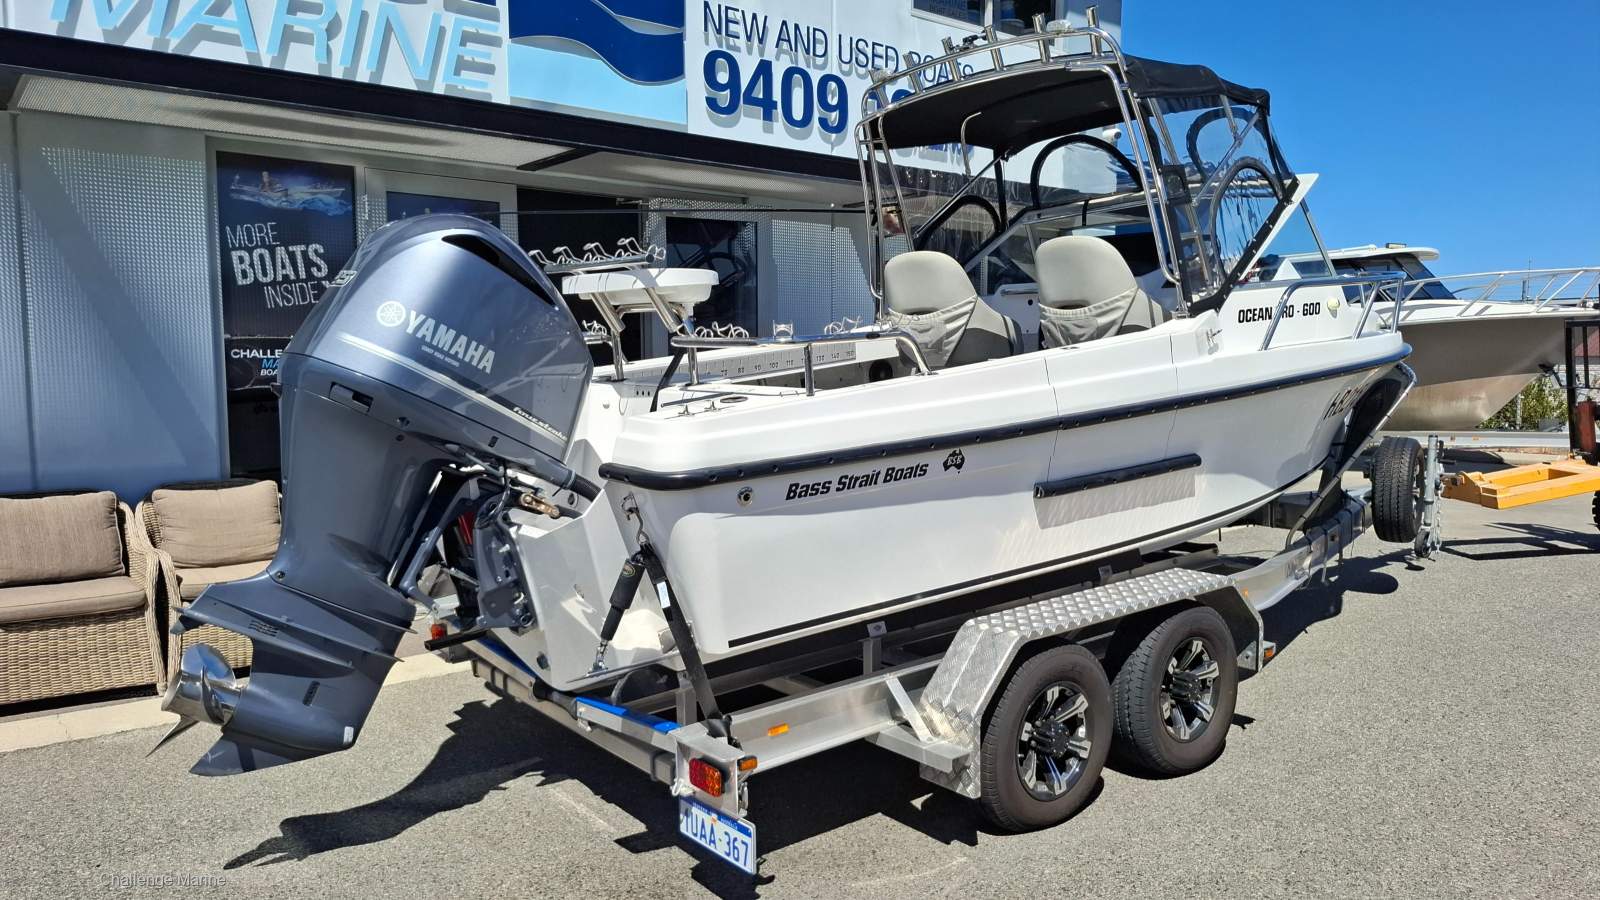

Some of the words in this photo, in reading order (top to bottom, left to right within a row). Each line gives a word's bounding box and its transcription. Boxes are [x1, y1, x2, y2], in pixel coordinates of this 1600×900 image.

[703, 0, 768, 45] NEW
[775, 19, 828, 58] AND
[838, 33, 899, 73] USED
[703, 50, 849, 134] 9409
[225, 222, 280, 248] MORE
[230, 243, 329, 286] BOATS
[263, 281, 319, 309] INSIDE
[1238, 306, 1273, 323] OCEAN
[1281, 304, 1295, 319] RO
[1302, 301, 1321, 317] 600
[405, 309, 496, 374] YAMAHA
[785, 478, 832, 501] Bass
[835, 468, 882, 493] Strait
[882, 461, 930, 485] Boats
